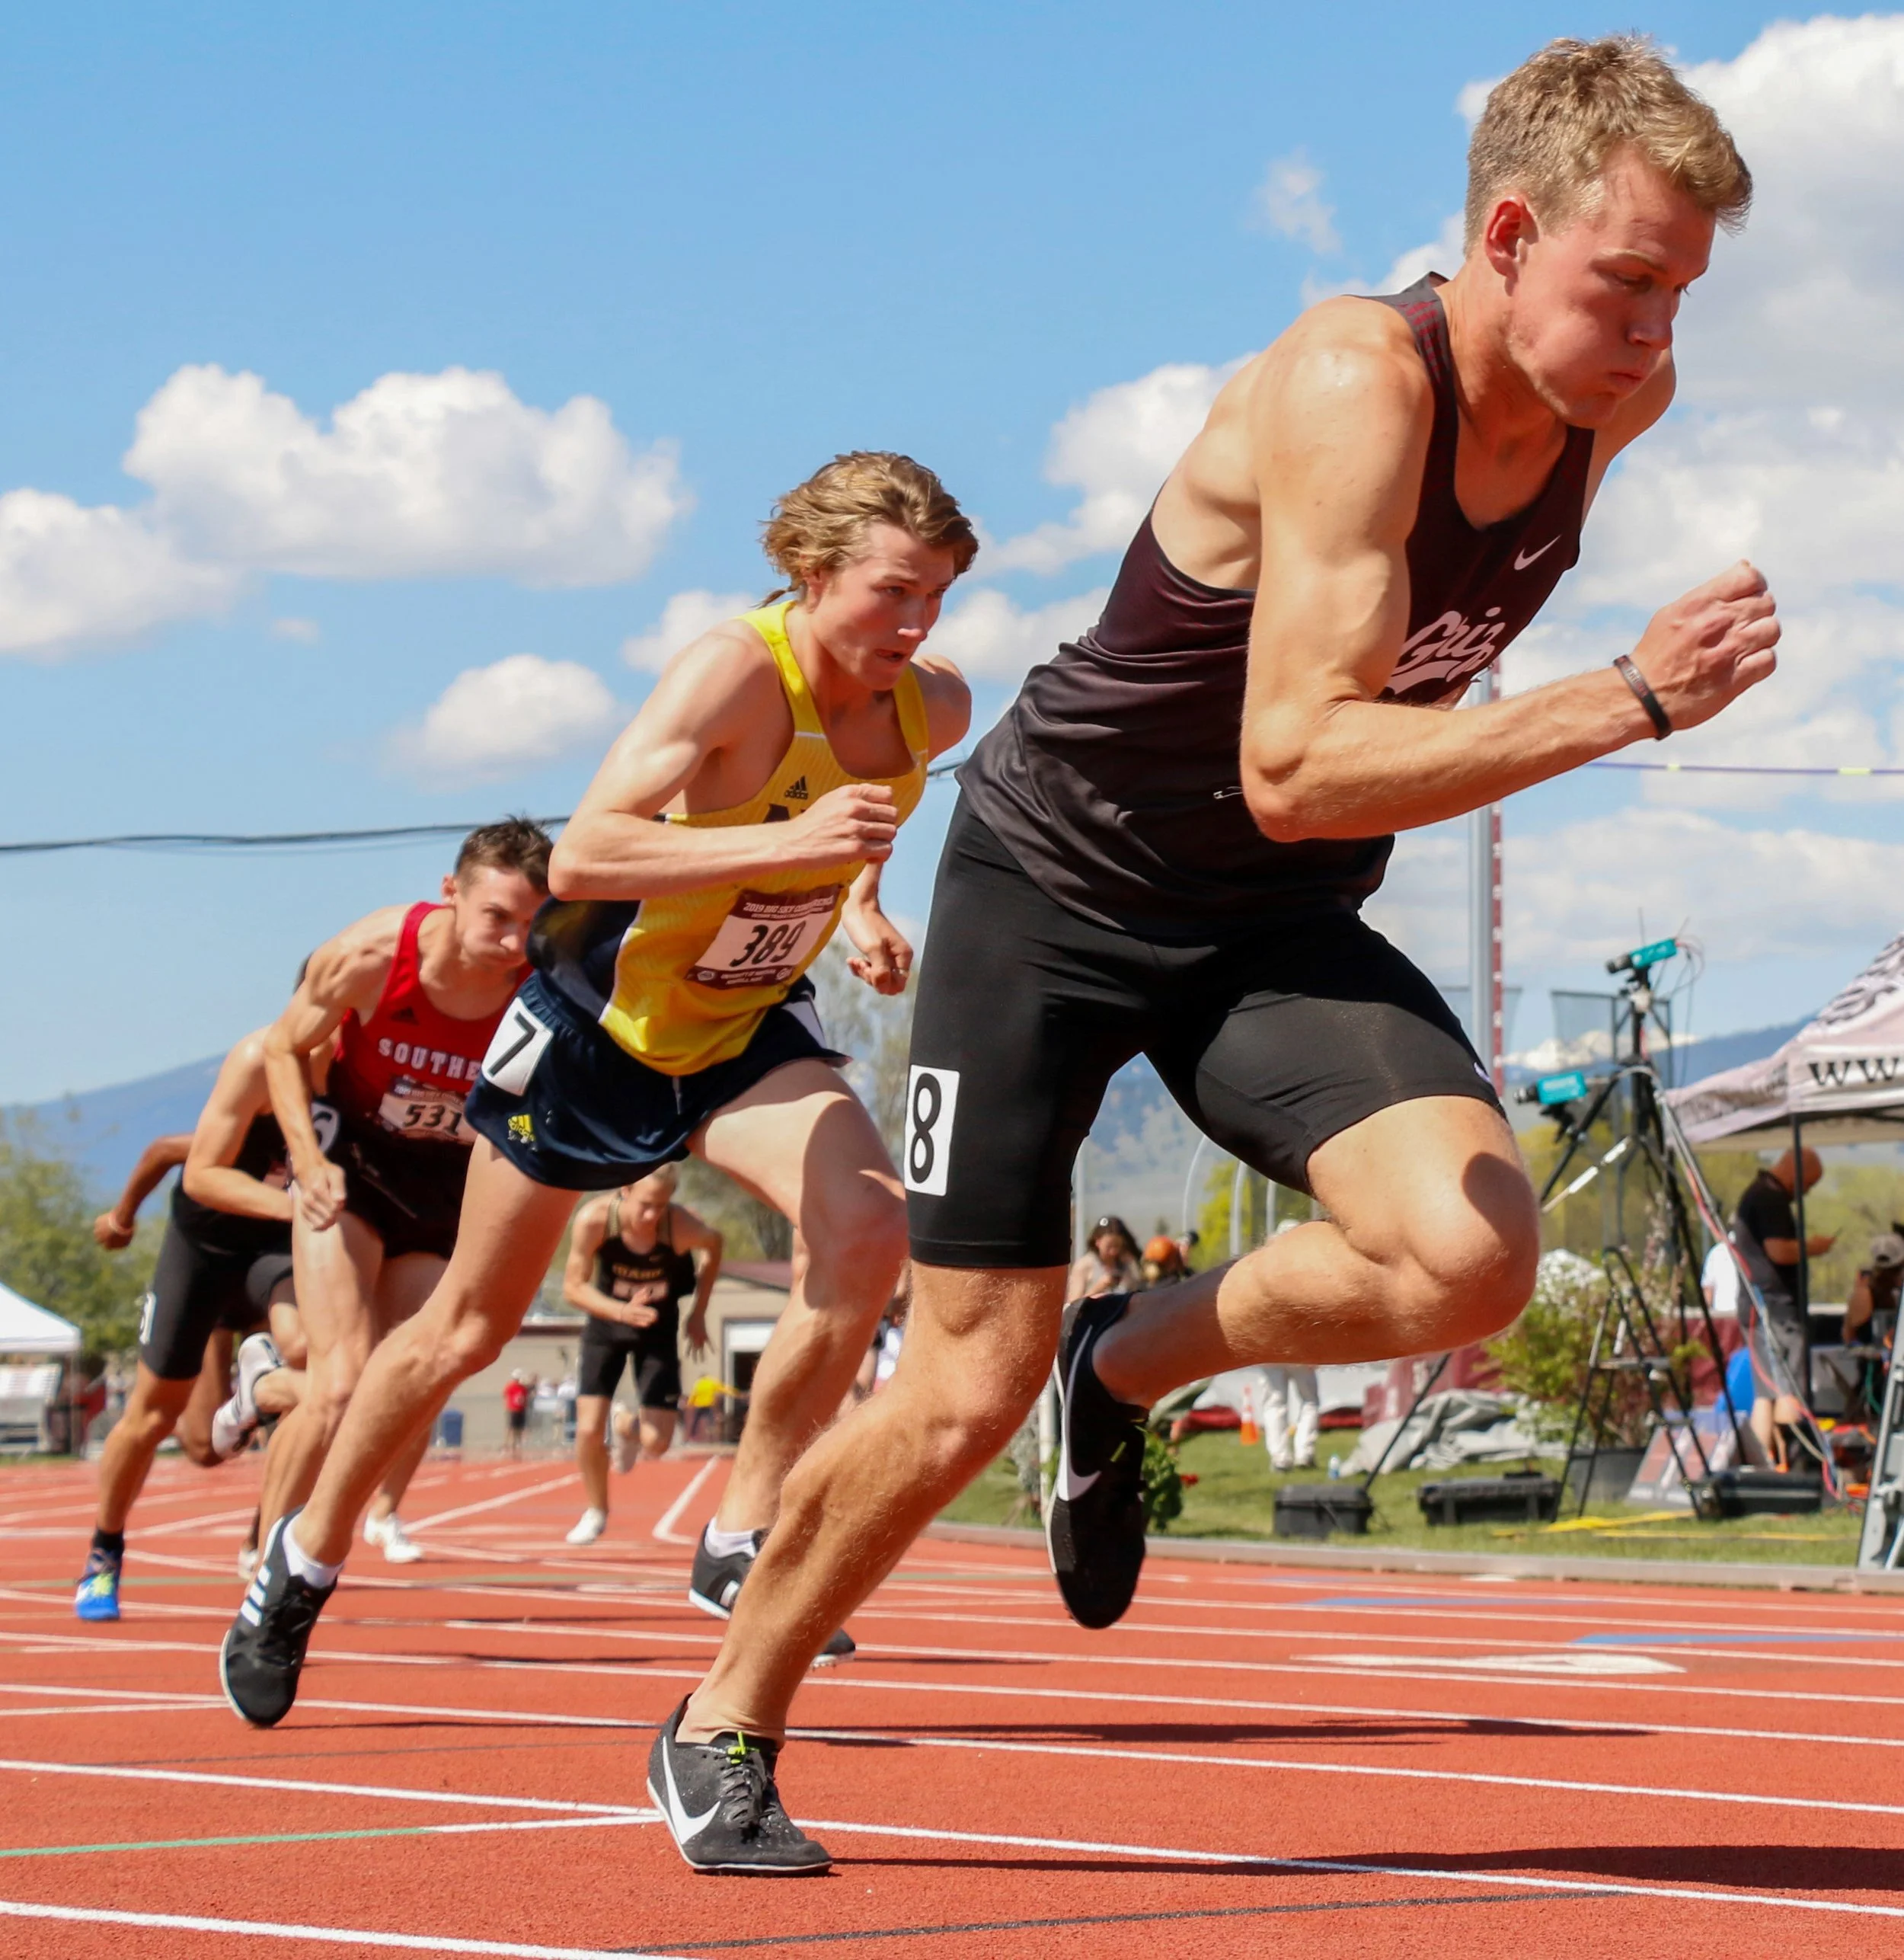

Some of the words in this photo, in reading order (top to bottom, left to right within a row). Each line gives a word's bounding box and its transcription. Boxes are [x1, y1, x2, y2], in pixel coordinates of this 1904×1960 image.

[784, 789, 808, 800] adidas
[743, 902, 764, 913] 2019
[764, 905, 779, 913] BIG
[777, 905, 795, 914] SKY
[729, 920, 806, 967] 389
[488, 1010, 538, 1078] 7
[403, 1103, 462, 1136] 531
[910, 1073, 942, 1184] 8
